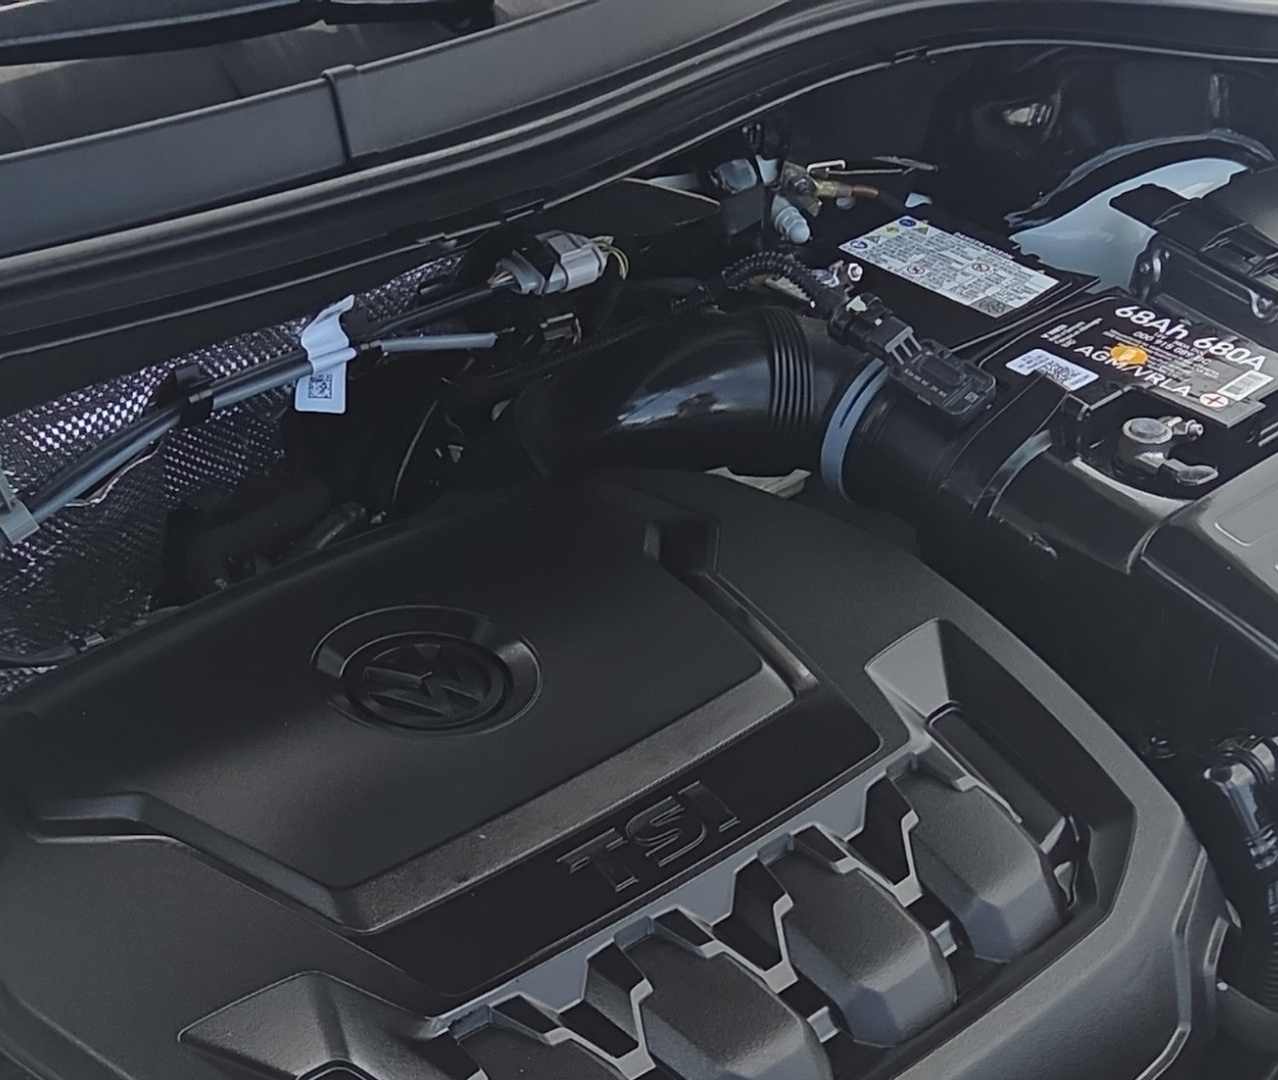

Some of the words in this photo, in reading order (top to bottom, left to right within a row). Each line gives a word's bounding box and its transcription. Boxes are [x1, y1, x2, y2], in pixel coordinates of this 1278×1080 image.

[1114, 305, 1189, 339] 68Ah
[1193, 337, 1266, 370] 680A
[556, 780, 741, 893] TSI
